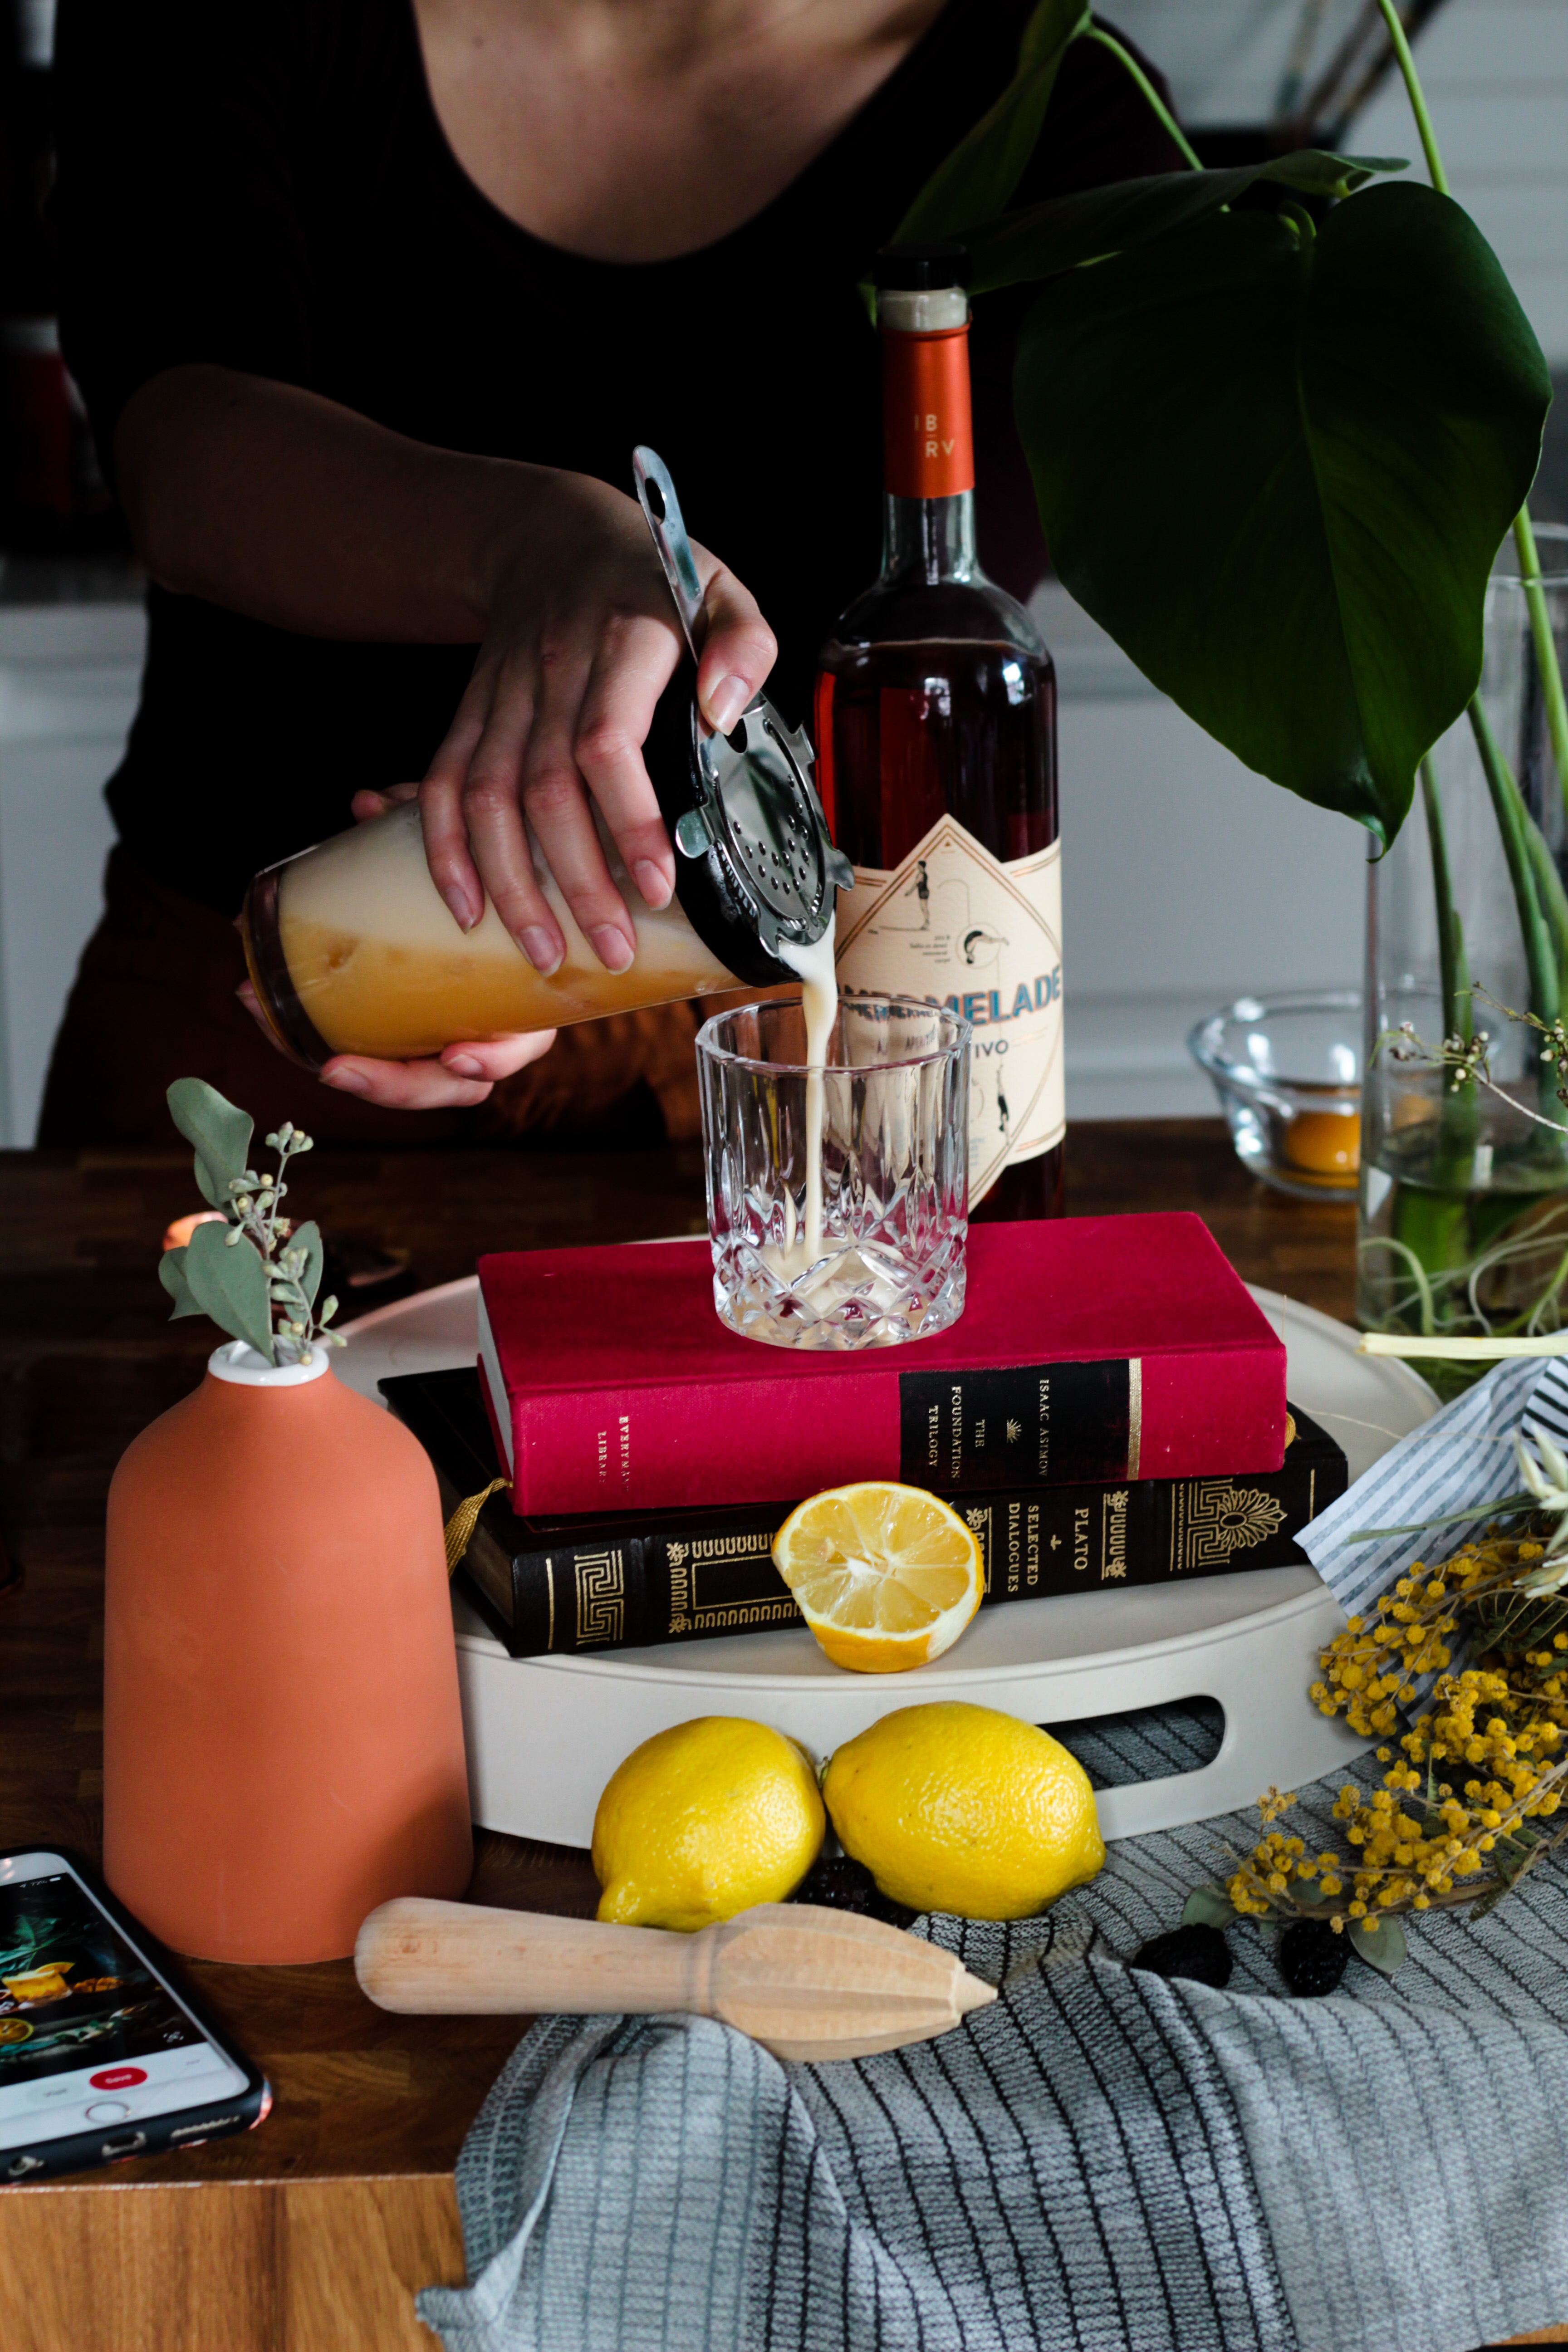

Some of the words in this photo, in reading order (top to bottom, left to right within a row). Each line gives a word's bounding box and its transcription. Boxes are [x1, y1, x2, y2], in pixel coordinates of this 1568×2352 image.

[1039, 1379, 1049, 1421] ISAAC
[928, 1405, 939, 1467] TRILOGY
[951, 1386, 962, 1478] FOUNDATION
[975, 1419, 985, 1447] THE
[1039, 1427, 1049, 1476] ASIMOV
[1008, 1503, 1020, 1592] DIALOGUES
[1027, 1505, 1039, 1585] SELECTED
[1074, 1508, 1089, 1570] PLATO
